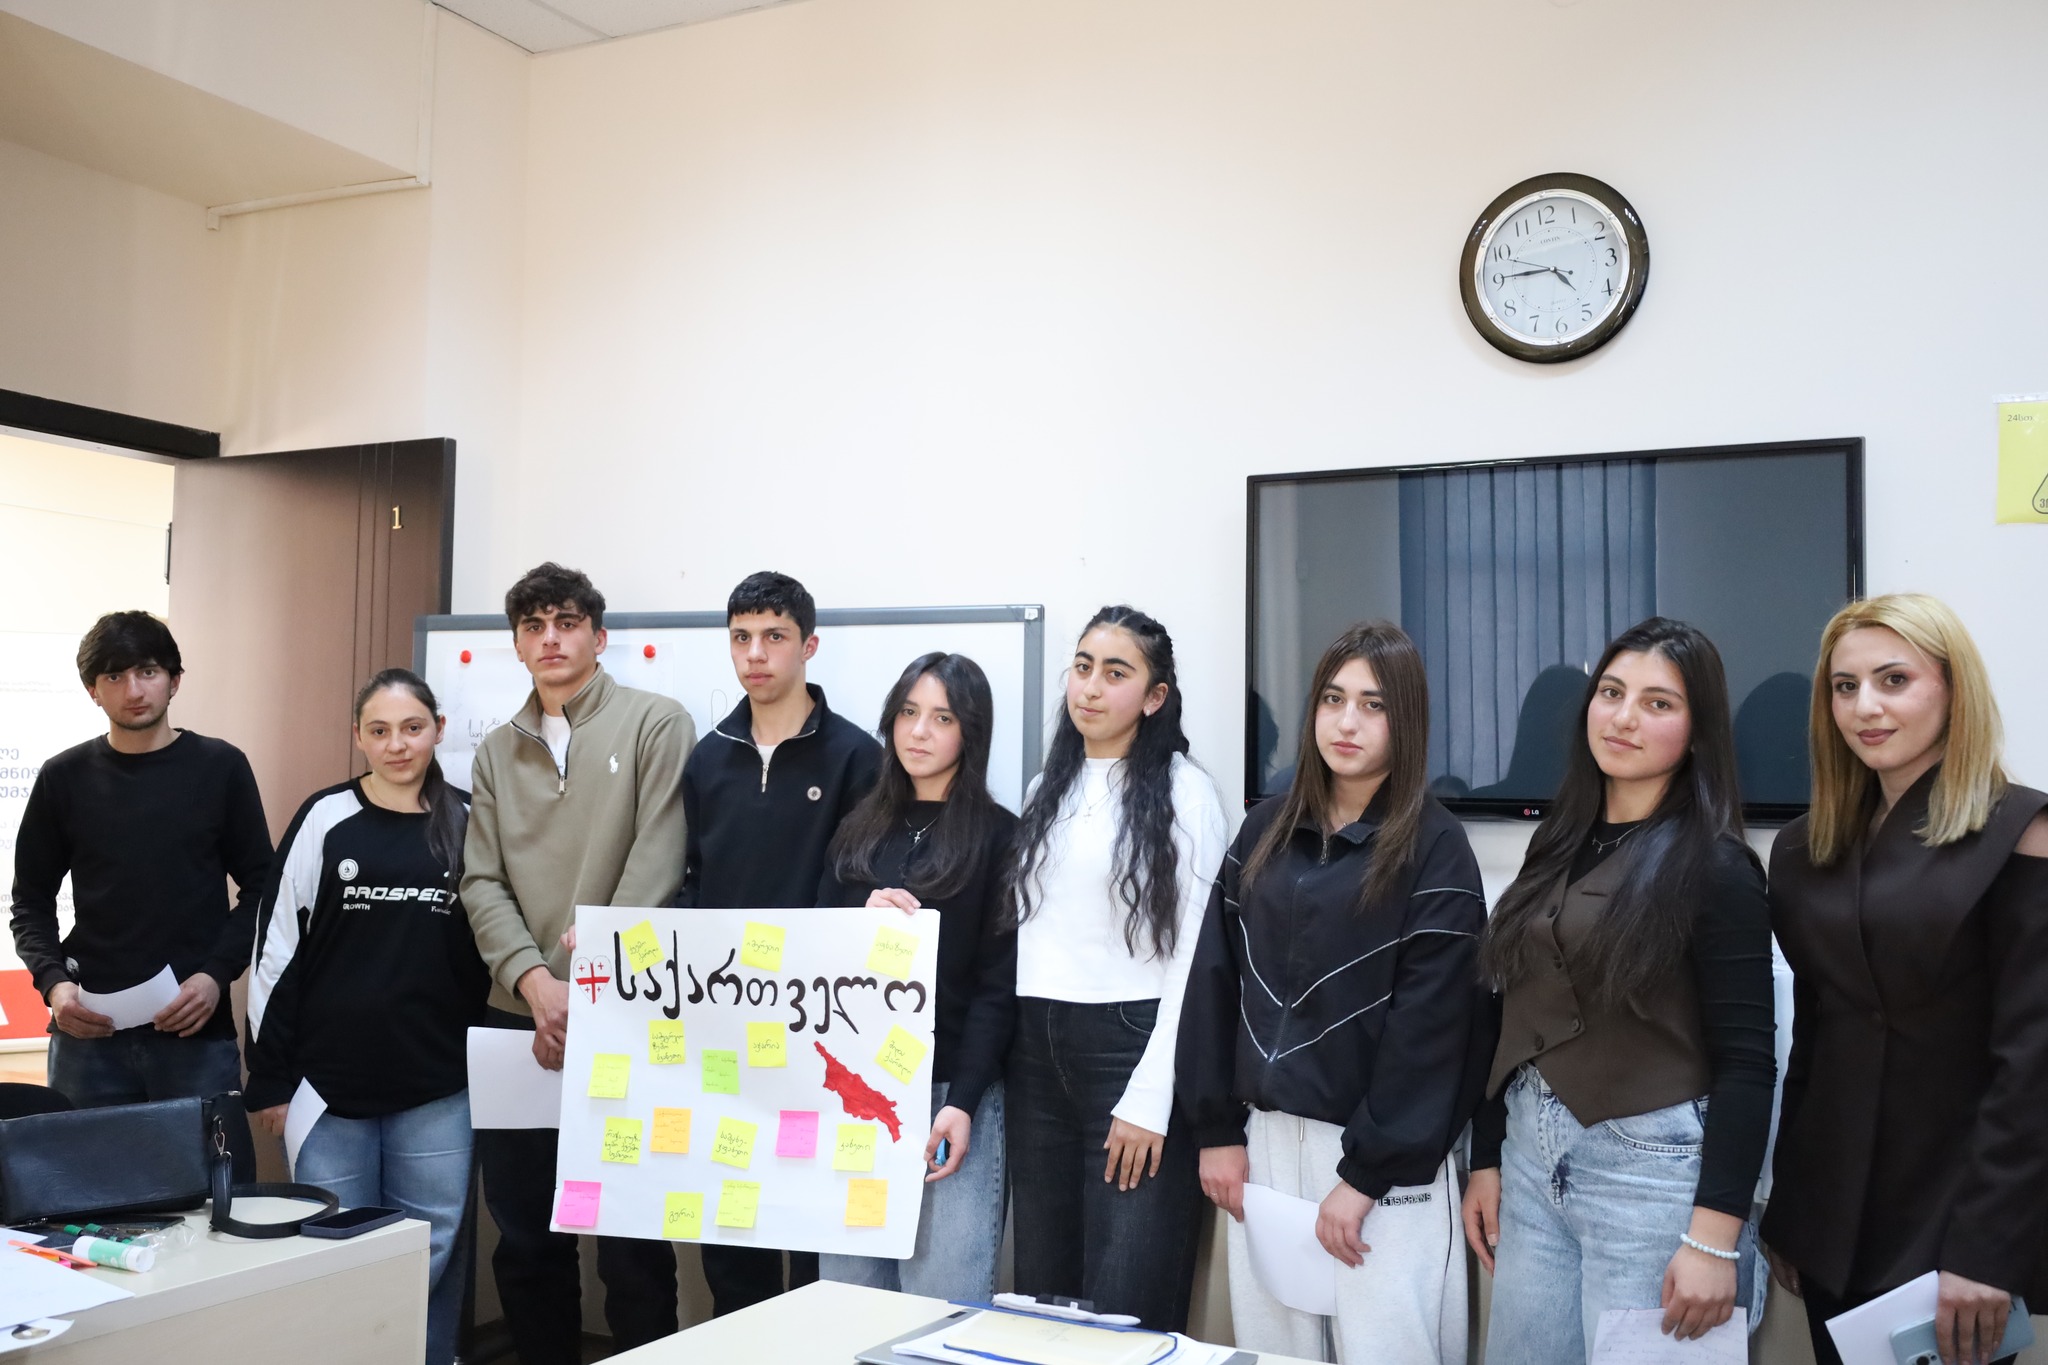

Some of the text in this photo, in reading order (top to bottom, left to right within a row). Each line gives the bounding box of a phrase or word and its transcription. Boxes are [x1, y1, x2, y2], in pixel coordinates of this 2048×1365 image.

[1537, 205, 1555, 226] 12
[1571, 206, 1577, 224] 1
[1515, 218, 1530, 237] 11
[1592, 221, 1606, 241] 2
[1493, 243, 1511, 263] 10
[1604, 247, 1618, 267] 3
[1492, 272, 1505, 292] 9
[1600, 278, 1614, 296] 4
[1504, 298, 1517, 317] 8
[1581, 302, 1593, 322] 5
[1529, 314, 1540, 333] 7
[1555, 315, 1568, 334] 6
[392, 505, 402, 529] 1
[342, 903, 371, 911] GROWTH
[614, 929, 926, 1034] საქართველო
